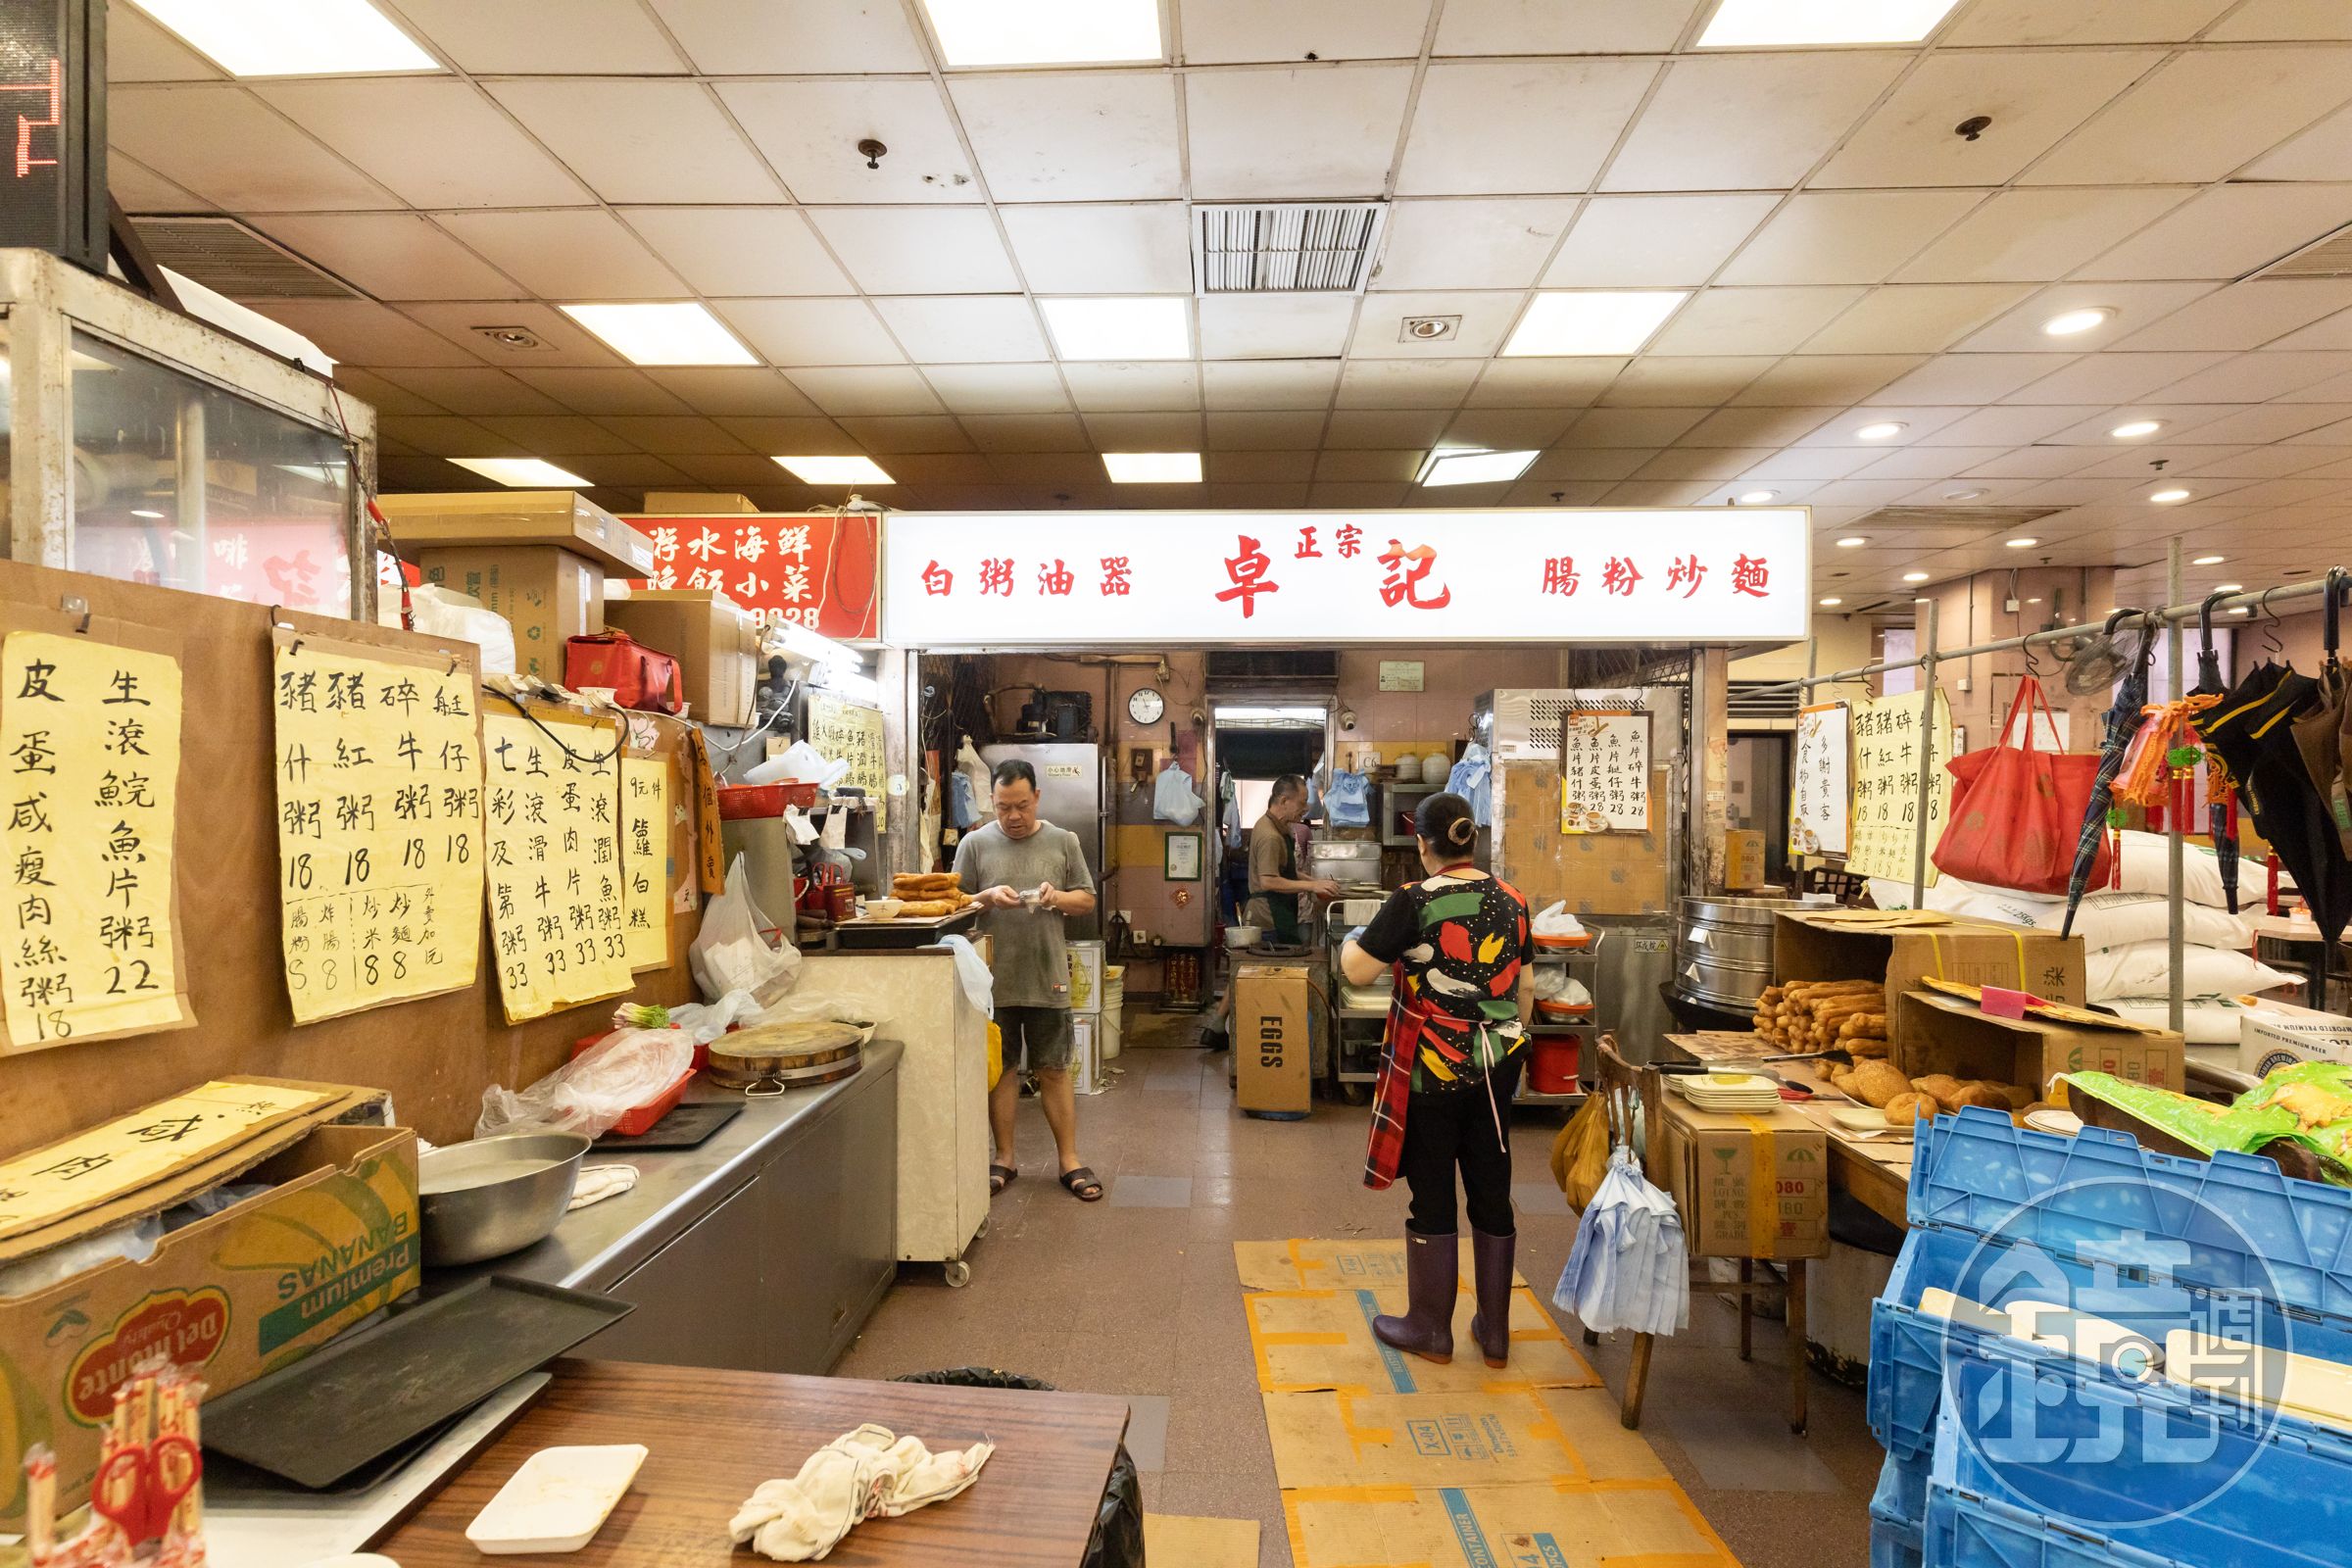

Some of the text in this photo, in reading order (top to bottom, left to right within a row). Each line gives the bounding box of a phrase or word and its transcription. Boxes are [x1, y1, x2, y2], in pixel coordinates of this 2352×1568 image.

[1294, 523, 1362, 560] 正宗
[921, 556, 1132, 597] 白粥油器
[1542, 554, 1771, 598] 腸粉炒麵
[1895, 710, 1918, 795] 碎牛粥
[280, 670, 322, 890] 豬什粥 18
[325, 671, 374, 886] 豬紅粥 18
[379, 677, 432, 869] 碎牛粥 18
[432, 687, 479, 863] 艇仔粥 18
[1818, 737, 1831, 821] 多謝貴客
[1590, 802, 1604, 811] 28
[1610, 804, 1624, 814] 28
[1631, 807, 1644, 815] 28
[1857, 808, 1867, 821] 18
[1877, 803, 1888, 820] 18
[1902, 802, 1914, 822] 18
[545, 949, 565, 975] 33
[576, 938, 596, 964] 33
[604, 934, 626, 958] 33
[106, 960, 159, 994] 22
[321, 958, 337, 990] 8
[393, 951, 407, 979] 8
[506, 963, 527, 989] 33
[36, 1009, 72, 1039] 18
[2254, 1027, 2280, 1041] IMPORTED
[2281, 1037, 2309, 1050] PREMIUM
[2311, 1045, 2327, 1054] BEER
[1260, 1016, 1283, 1067] EGGS
[277, 1211, 409, 1300] BANANAS
[301, 1243, 410, 1320] Premium
[178, 1311, 218, 1348] Del
